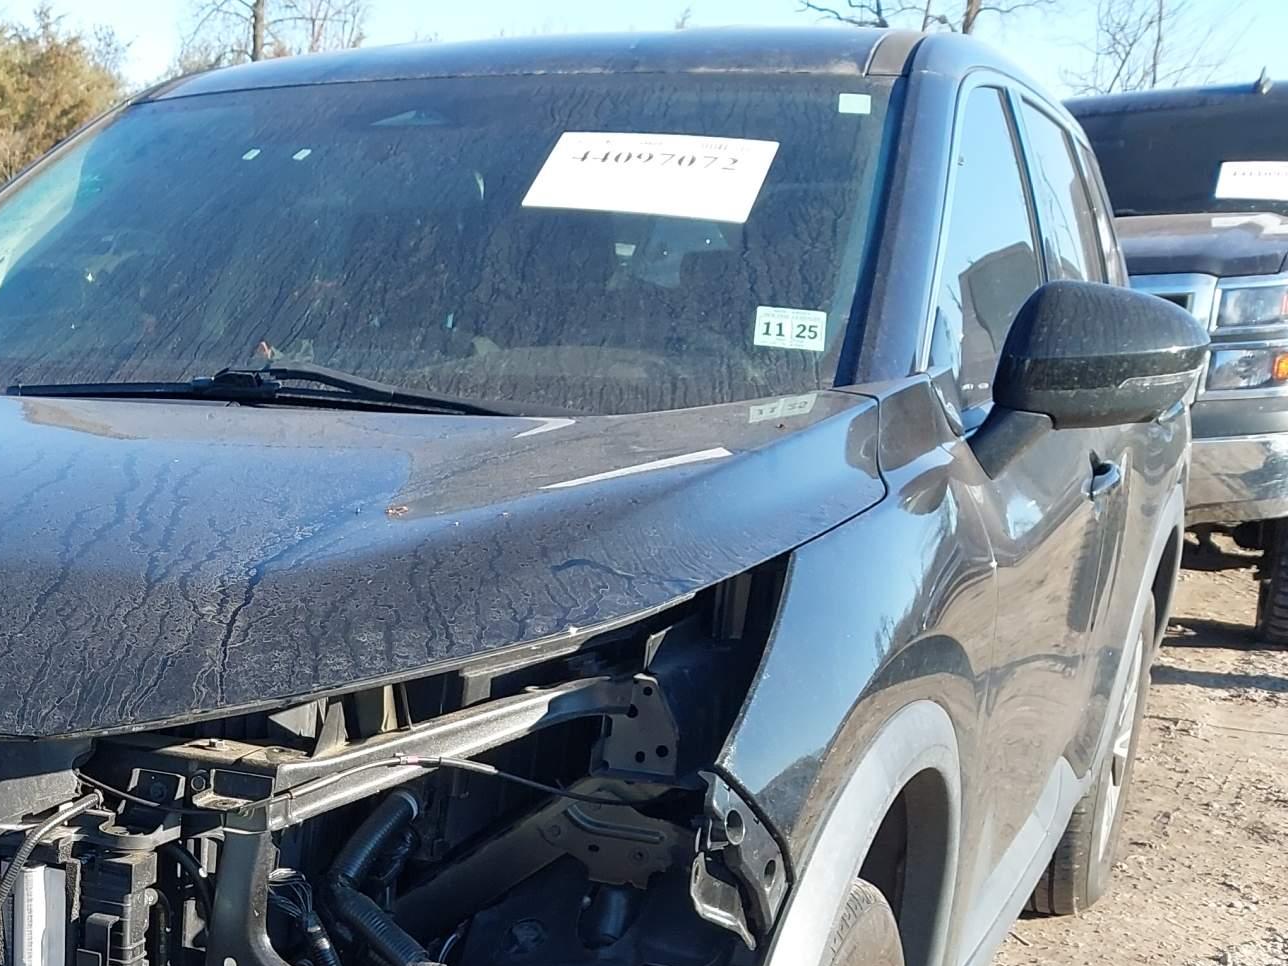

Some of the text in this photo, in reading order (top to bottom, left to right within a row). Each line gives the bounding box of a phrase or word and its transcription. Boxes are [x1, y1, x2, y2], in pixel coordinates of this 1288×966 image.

[572, 150, 739, 171] 44097072
[762, 321, 818, 340] 11 25
